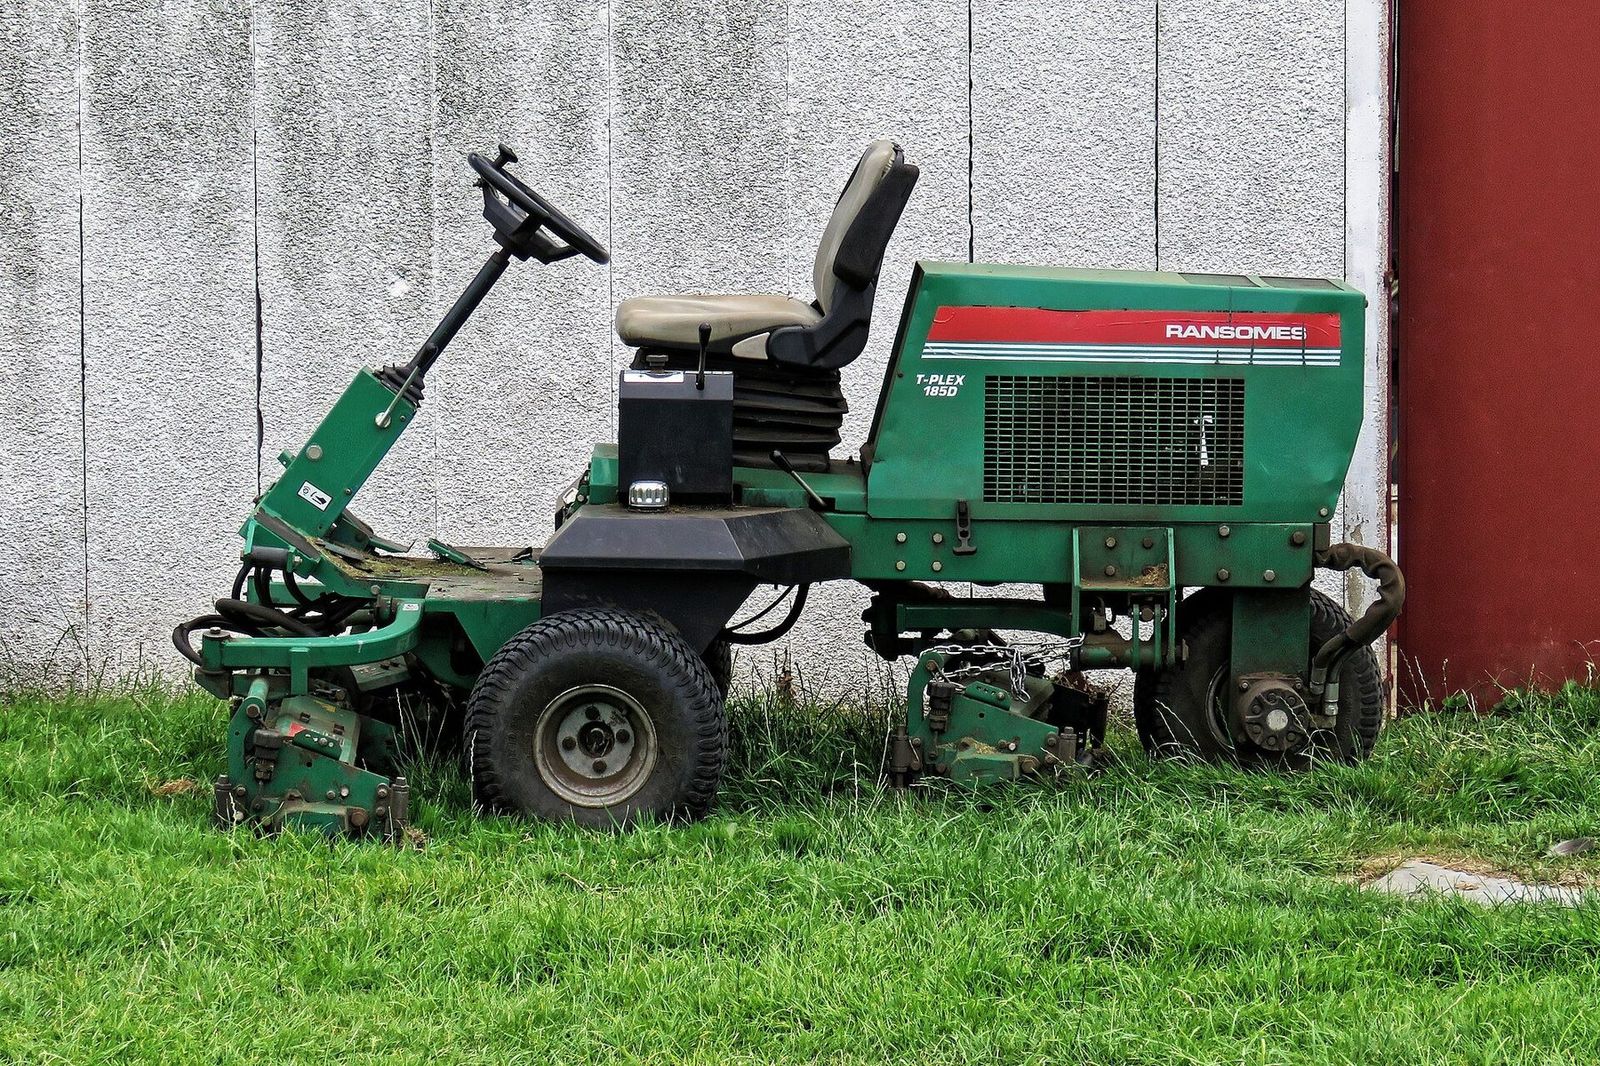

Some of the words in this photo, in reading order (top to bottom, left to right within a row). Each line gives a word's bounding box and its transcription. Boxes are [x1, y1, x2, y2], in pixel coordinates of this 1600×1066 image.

[1165, 324, 1307, 341] RANSOMES
[916, 374, 966, 386] T-PLEX
[923, 385, 958, 397] 185D
